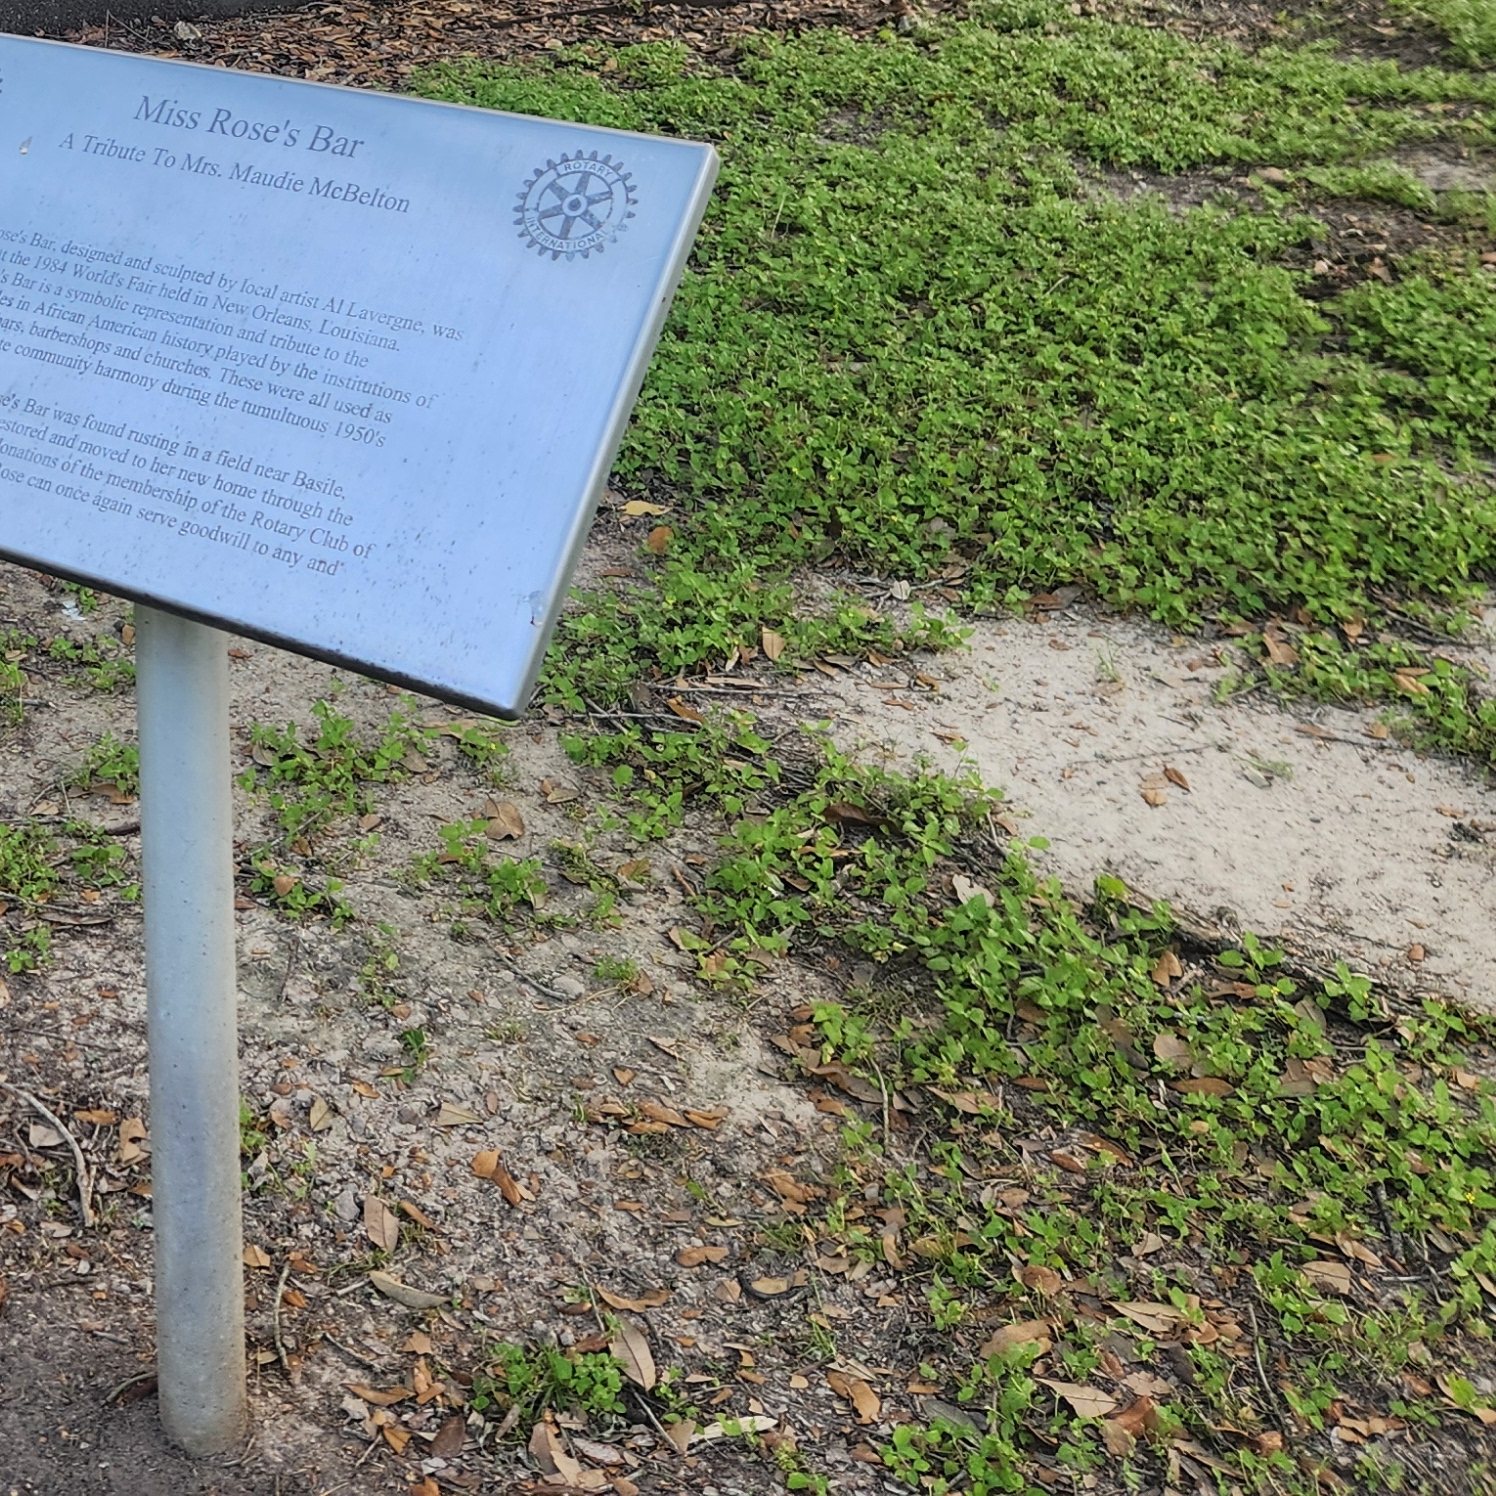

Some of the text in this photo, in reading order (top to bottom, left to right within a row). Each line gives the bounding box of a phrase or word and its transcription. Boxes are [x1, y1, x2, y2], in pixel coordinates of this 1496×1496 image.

[58, 132, 410, 213] A Tribute To Mrs. Maudie McBelton
[132, 94, 365, 159] Miss Rose's Bar
[563, 161, 614, 177] ROTARY
[525, 216, 610, 250] INTERNATIONAL
[8, 249, 31, 267] the
[33, 255, 69, 275] 1984
[72, 263, 125, 288] World's
[125, 275, 157, 295] Fair
[157, 282, 193, 303] held
[192, 291, 209, 307] in
[211, 294, 249, 315] New
[251, 304, 312, 334] Orleans,
[318, 318, 400, 352] Louisiana.
[10, 271, 38, 290] Bar
[38, 279, 52, 294] is
[53, 285, 63, 296] a
[64, 288, 129, 311] symbolic
[131, 303, 234, 337] representation
[236, 327, 268, 344] and
[268, 333, 320, 357] tribute
[323, 346, 340, 361] to
[342, 349, 369, 368] the
[60, 239, 124, 265] designed
[123, 256, 154, 271] and
[152, 263, 216, 286] sculpted
[217, 272, 238, 293] by
[239, 277, 279, 300] local
[279, 290, 320, 309] artist
[321, 296, 345, 314] Al
[345, 301, 425, 336] Lavergne,
[433, 324, 464, 341] was
[13, 344, 92, 376] community
[93, 359, 159, 392] harmony
[161, 377, 212, 407] during
[213, 390, 240, 410] the
[240, 399, 329, 433] tumultuous
[334, 420, 386, 448] 1950's
[15, 295, 31, 312] in
[32, 300, 86, 325] African
[86, 313, 158, 342] American
[159, 329, 214, 358] history
[213, 344, 269, 369] played
[269, 355, 291, 377] by
[292, 361, 319, 381] the
[321, 368, 412, 404] institutions
[415, 393, 439, 409] of
[28, 320, 112, 355] barbershops
[113, 345, 143, 361] and
[143, 347, 211, 380] churches.
[219, 366, 264, 392] These
[267, 381, 305, 402] were
[308, 391, 332, 409] all
[333, 399, 374, 419] used
[373, 410, 393, 424] as
[21, 397, 51, 418] Bar
[52, 409, 81, 426] was
[81, 413, 127, 438] found
[126, 429, 180, 457] rusting
[182, 441, 199, 459] in
[200, 450, 213, 462] a
[214, 449, 254, 473] field
[253, 464, 290, 483] near
[291, 469, 345, 501] Basile,
[48, 432, 80, 449] and
[77, 440, 130, 464] moved
[131, 453, 147, 469] to
[149, 455, 177, 477] her
[176, 467, 211, 486] new
[212, 473, 257, 500] home
[260, 488, 323, 520] through
[326, 506, 353, 527] the
[26, 475, 52, 493] can
[54, 483, 90, 503] once
[91, 491, 133, 516] again
[136, 507, 178, 528] serve
[177, 517, 251, 550] goodwill
[252, 540, 269, 556] to
[271, 547, 304, 569] any
[306, 557, 340, 576] and
[60, 456, 82, 474] of
[79, 462, 105, 481] the
[104, 472, 198, 514] membership
[200, 498, 222, 515] of
[220, 502, 247, 523] the
[249, 509, 305, 543] Rotary
[309, 527, 349, 552] Club
[352, 542, 377, 559] of
